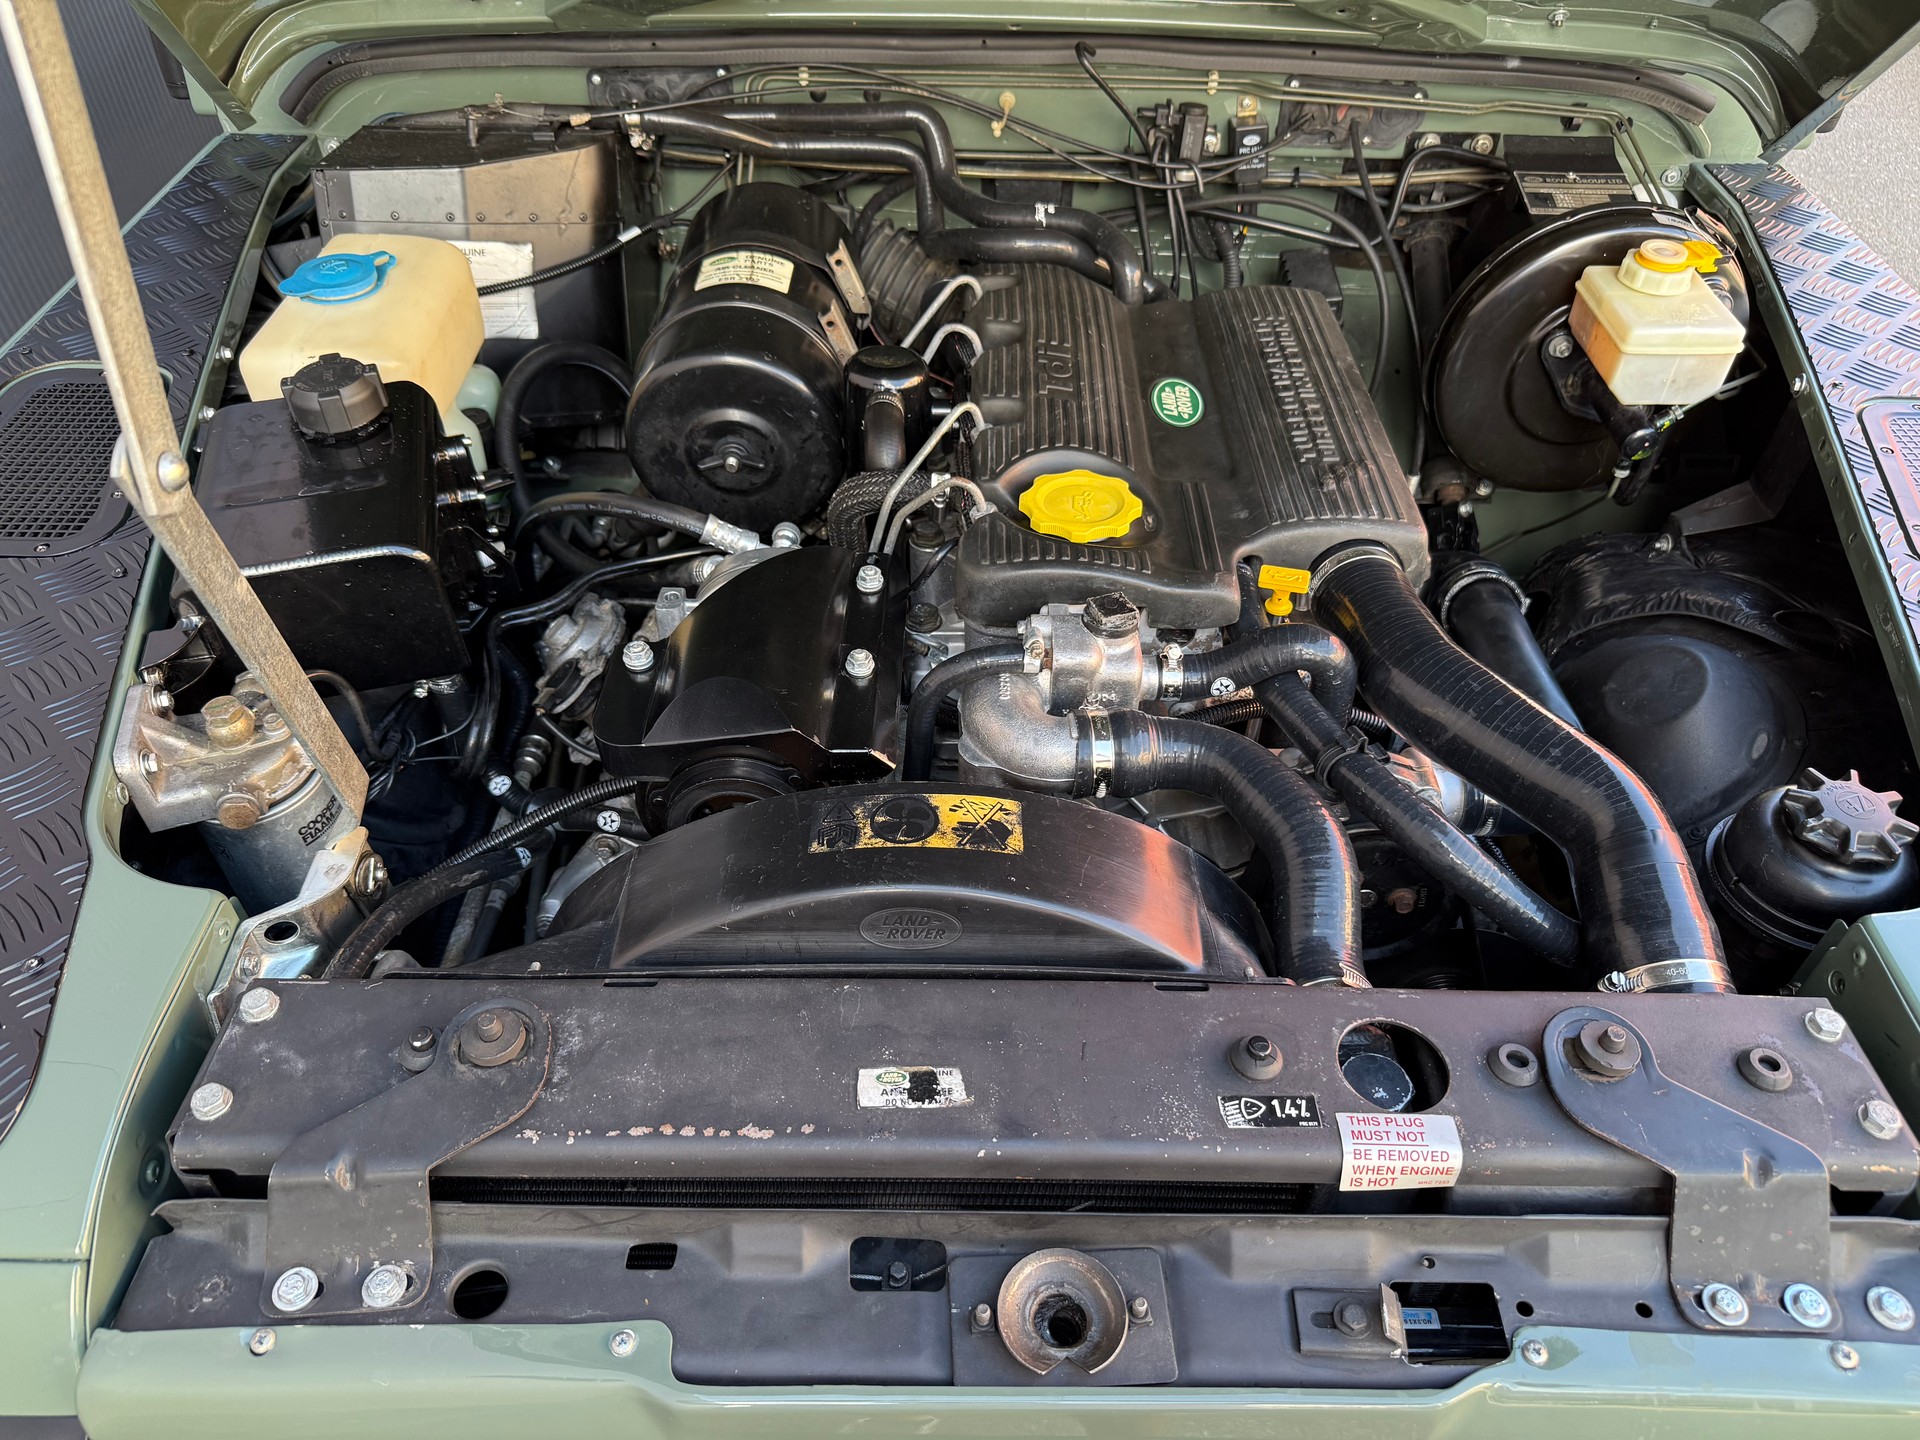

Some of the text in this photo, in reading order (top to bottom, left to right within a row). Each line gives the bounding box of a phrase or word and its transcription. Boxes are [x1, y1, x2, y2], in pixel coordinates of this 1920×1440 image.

[1037, 349, 1075, 395] Tdi
[298, 795, 338, 836] COOPER
[301, 811, 335, 844] FIAAM
[880, 915, 932, 927] LAND
[886, 928, 947, 940] ROVER
[1666, 967, 1689, 976] 40-60
[885, 1098, 897, 1106] DO
[1347, 1115, 1425, 1128] THIS PLUG
[1350, 1130, 1426, 1142] MUST NOT
[1353, 1148, 1450, 1162] BE REMOVED
[1352, 1164, 1455, 1176] WHEN ENGINE
[1349, 1177, 1363, 1187] IS
[1367, 1177, 1398, 1187] HOT
